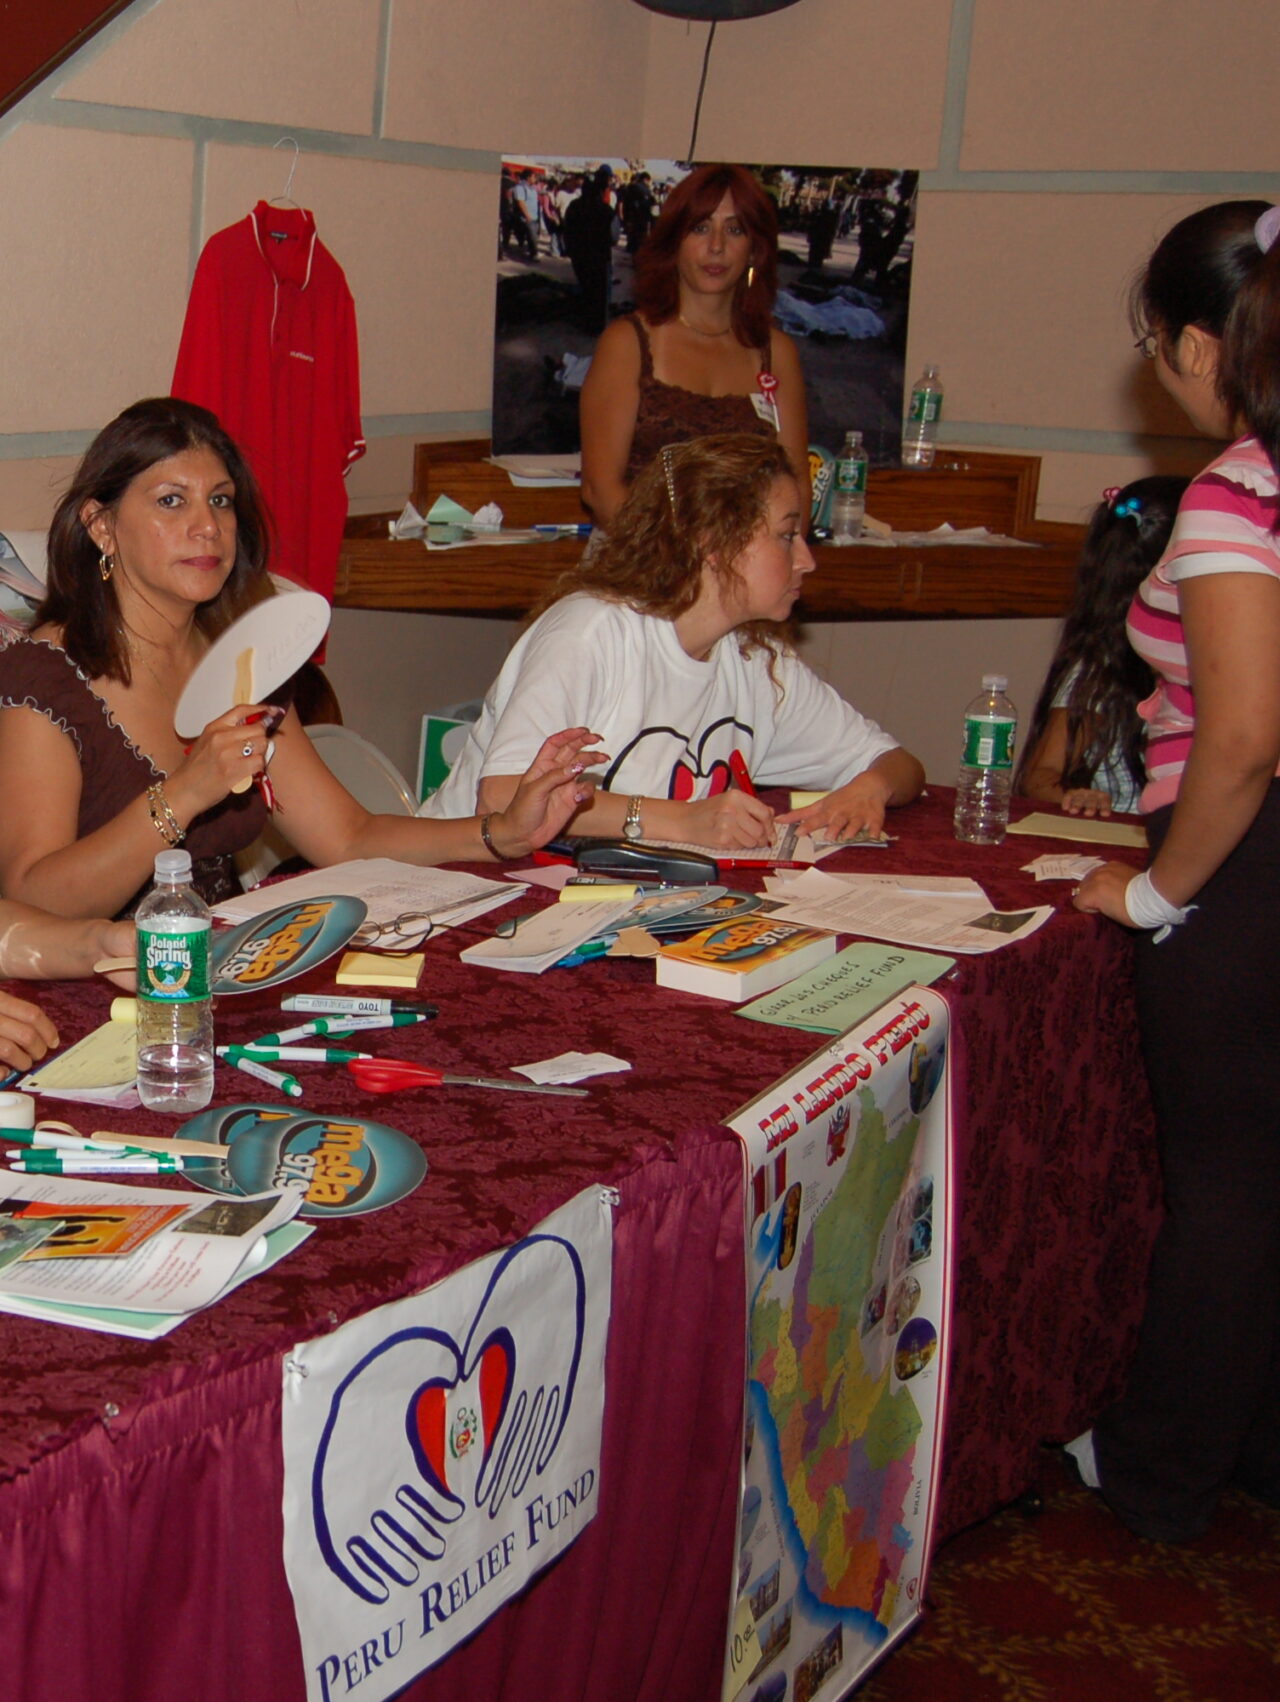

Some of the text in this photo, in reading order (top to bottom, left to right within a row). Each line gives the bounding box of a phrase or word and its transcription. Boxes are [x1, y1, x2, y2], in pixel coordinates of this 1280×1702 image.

[150, 934, 187, 949] Poland
[236, 902, 336, 983] mega
[690, 921, 777, 961] mega
[752, 926, 799, 946] 97.9
[146, 947, 192, 970] Spring
[220, 938, 271, 980] 97.9
[870, 954, 906, 978] FUND
[358, 1002, 380, 1013] TOYO
[758, 1104, 799, 1153] MI
[793, 1053, 872, 1125] LINDO
[307, 1123, 365, 1203] mega
[316, 1468, 596, 1702] PERU RELIEF FUND
